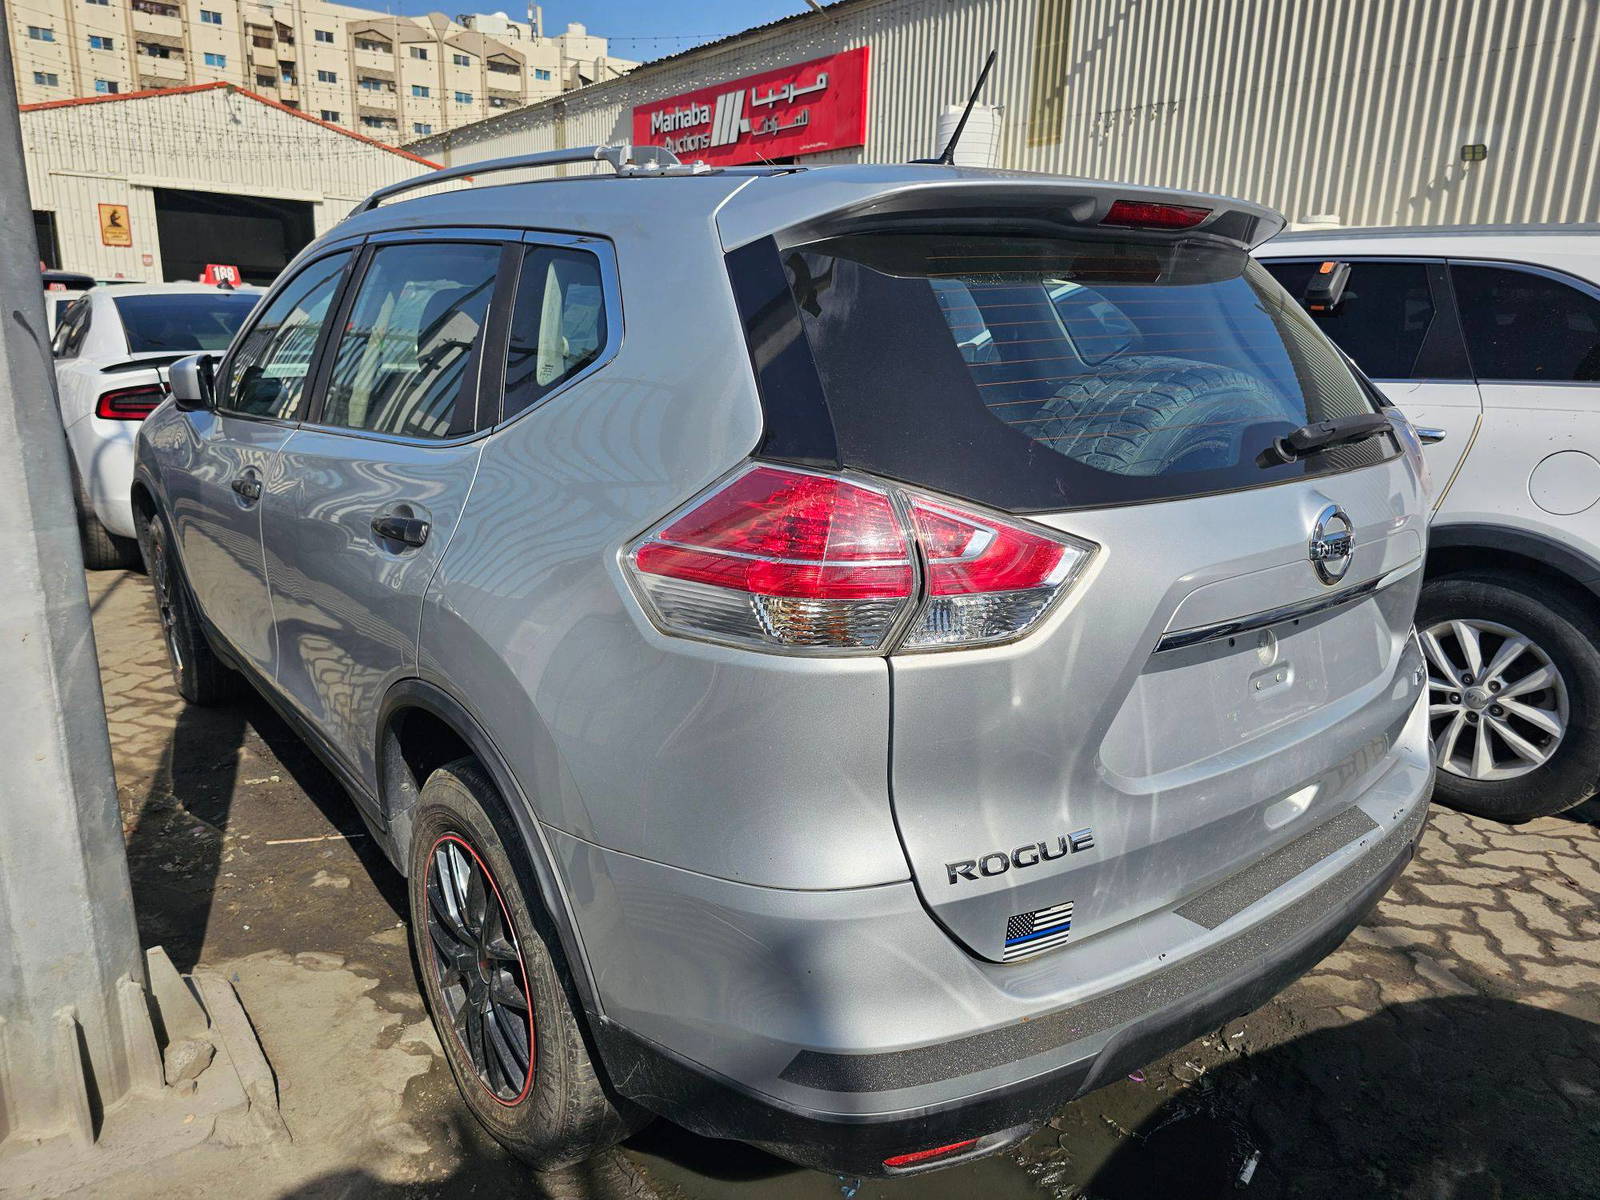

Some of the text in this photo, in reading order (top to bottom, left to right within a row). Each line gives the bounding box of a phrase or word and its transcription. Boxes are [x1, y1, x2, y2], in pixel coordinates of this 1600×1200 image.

[752, 72, 828, 108] مرحبا
[651, 102, 711, 135] Marhaba
[665, 132, 710, 154] Auctions
[945, 827, 1095, 885] ROGUE
